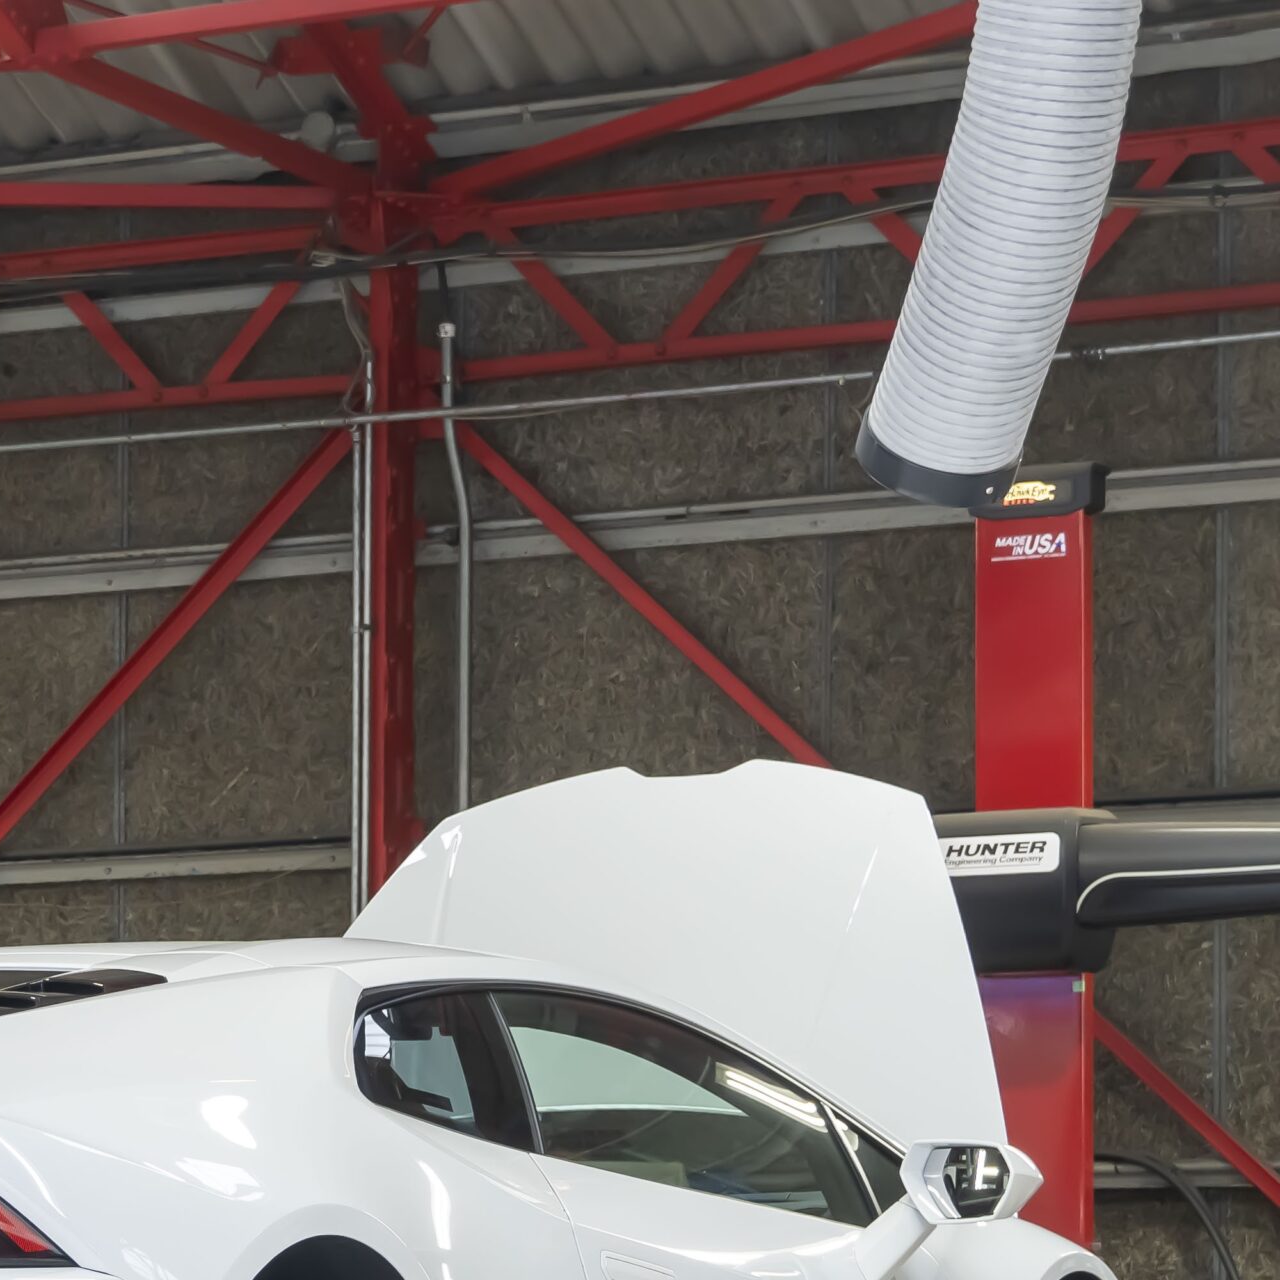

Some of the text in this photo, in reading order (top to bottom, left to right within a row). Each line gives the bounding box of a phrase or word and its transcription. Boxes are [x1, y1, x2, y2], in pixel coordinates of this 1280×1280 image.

[995, 535, 1026, 548] MADE
[1023, 532, 1066, 555] USA
[1012, 546, 1024, 556] IN
[946, 840, 1047, 858] HUNTER
[999, 855, 1043, 864] Company
